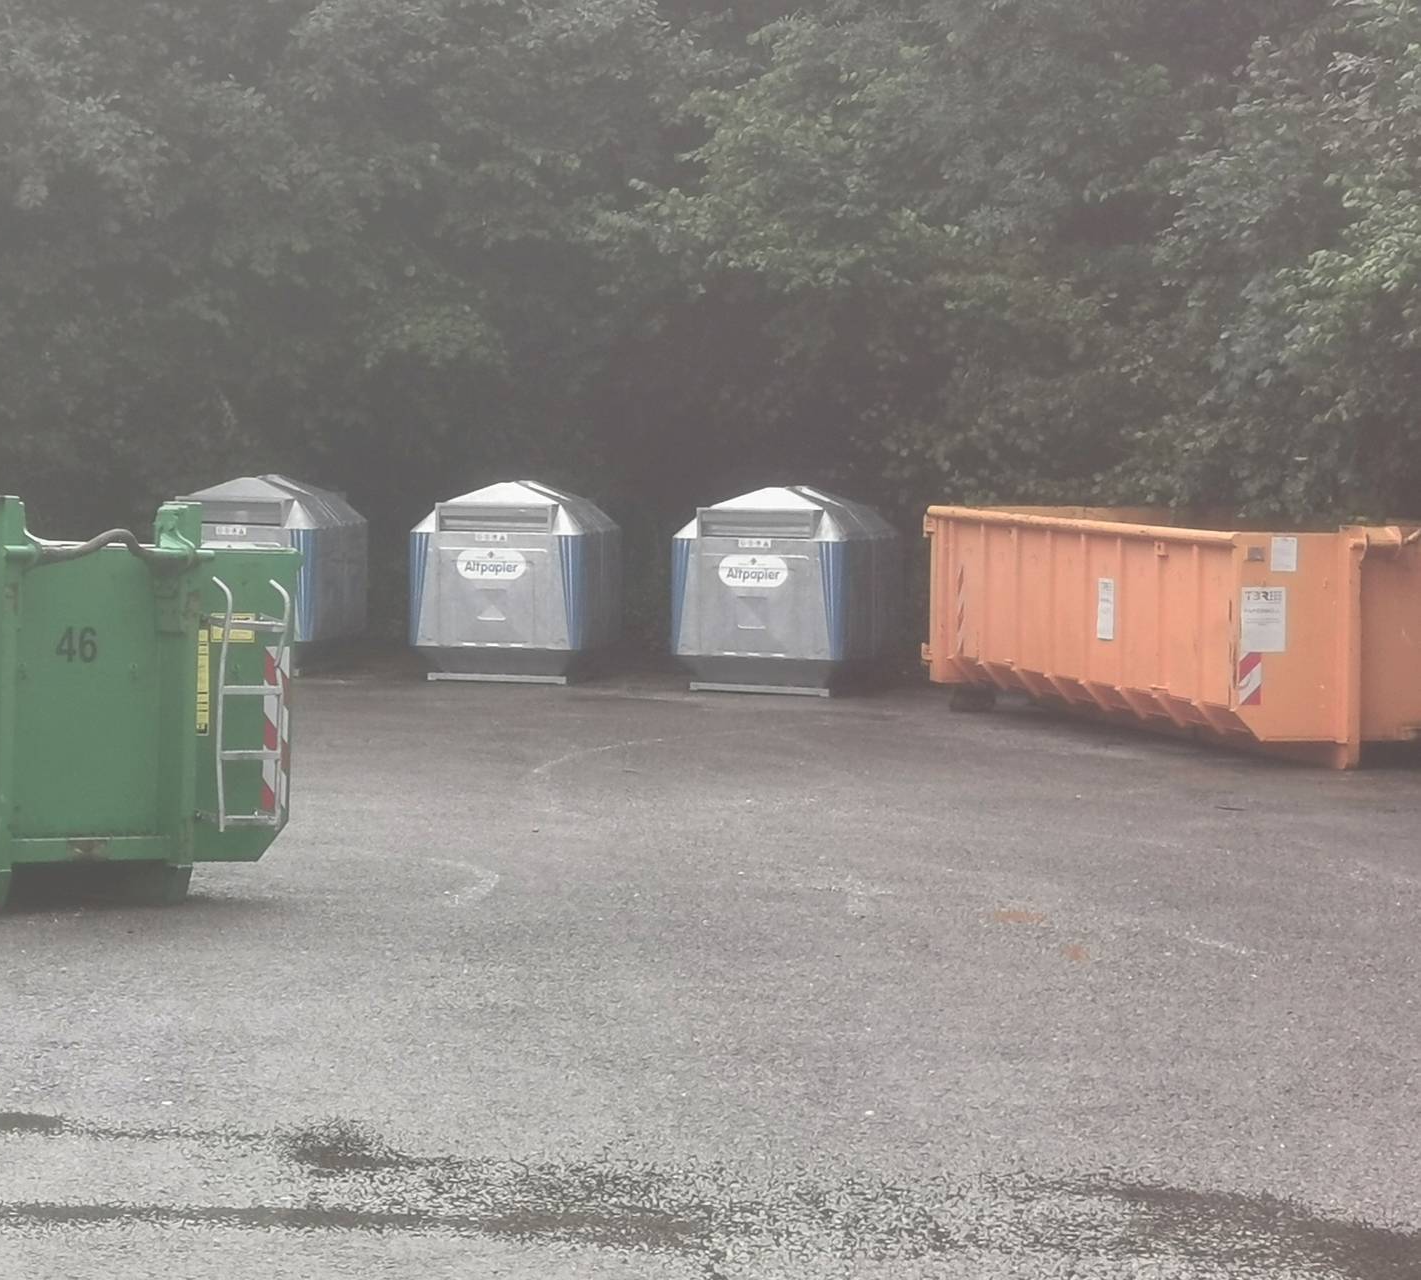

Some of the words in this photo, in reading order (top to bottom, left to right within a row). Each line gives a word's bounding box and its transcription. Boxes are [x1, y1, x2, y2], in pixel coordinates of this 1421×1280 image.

[464, 560, 518, 576] Altpapier
[726, 567, 781, 583] Altpapier
[56, 626, 98, 663] 46
